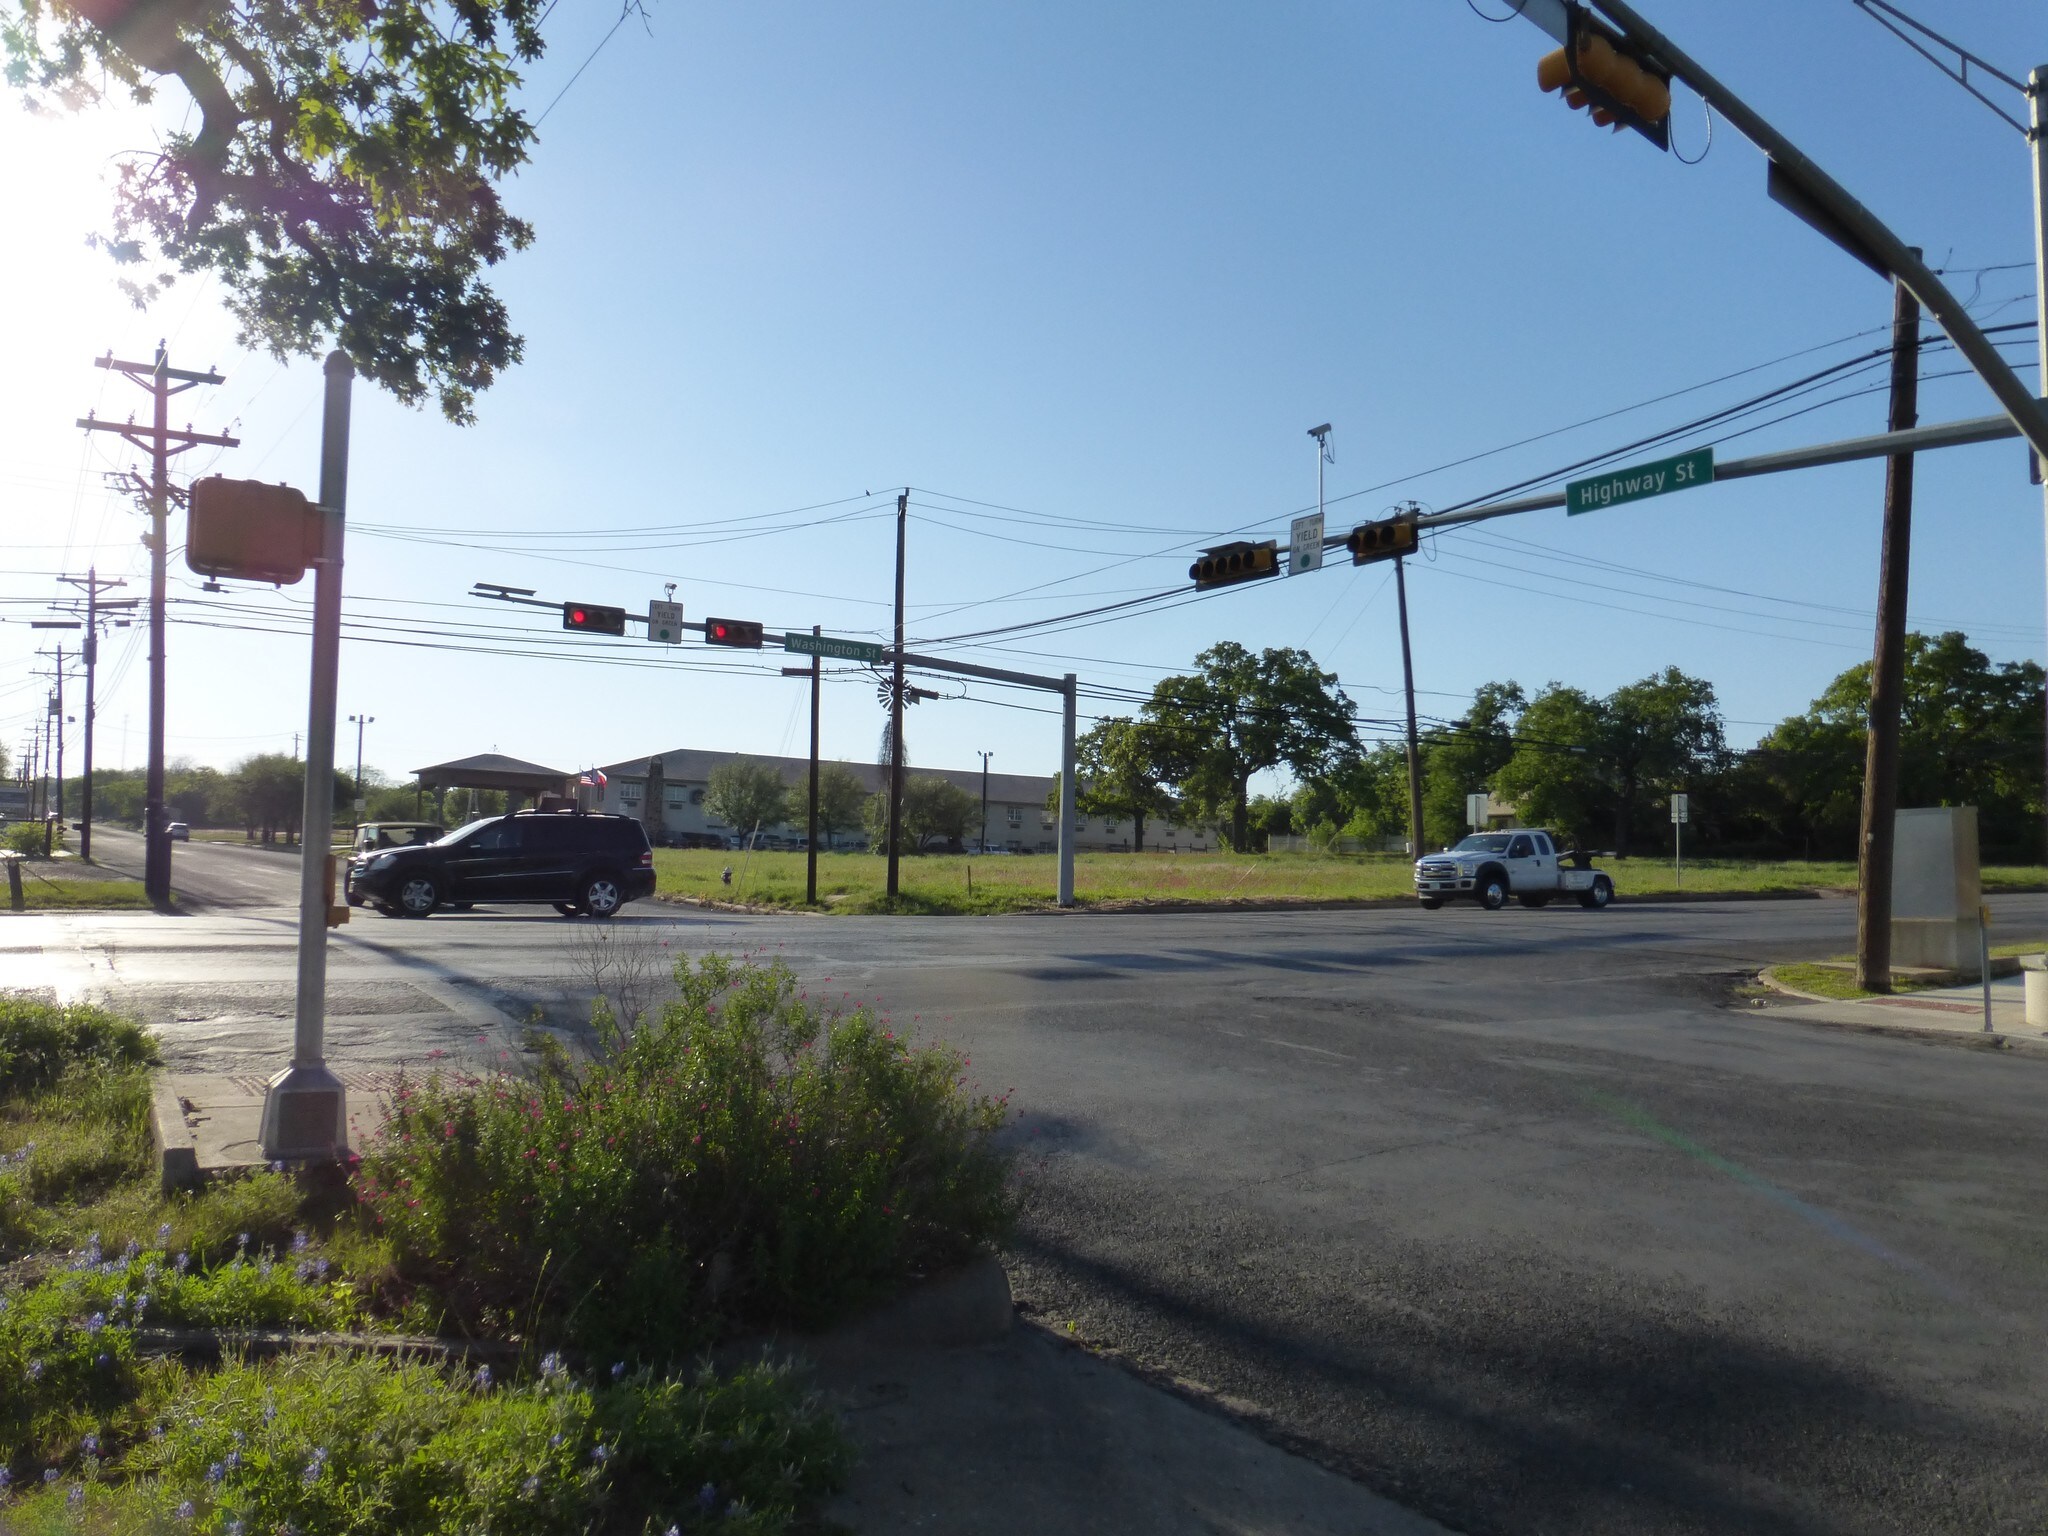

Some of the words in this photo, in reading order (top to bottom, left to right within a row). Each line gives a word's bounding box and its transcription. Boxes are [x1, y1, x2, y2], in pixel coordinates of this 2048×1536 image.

[1581, 471, 1666, 505] Highway
[1675, 461, 1695, 482] St
[1296, 528, 1318, 542] YIELD
[657, 611, 675, 619] YIELD
[791, 638, 860, 656] Washington
[866, 647, 876, 658] St
